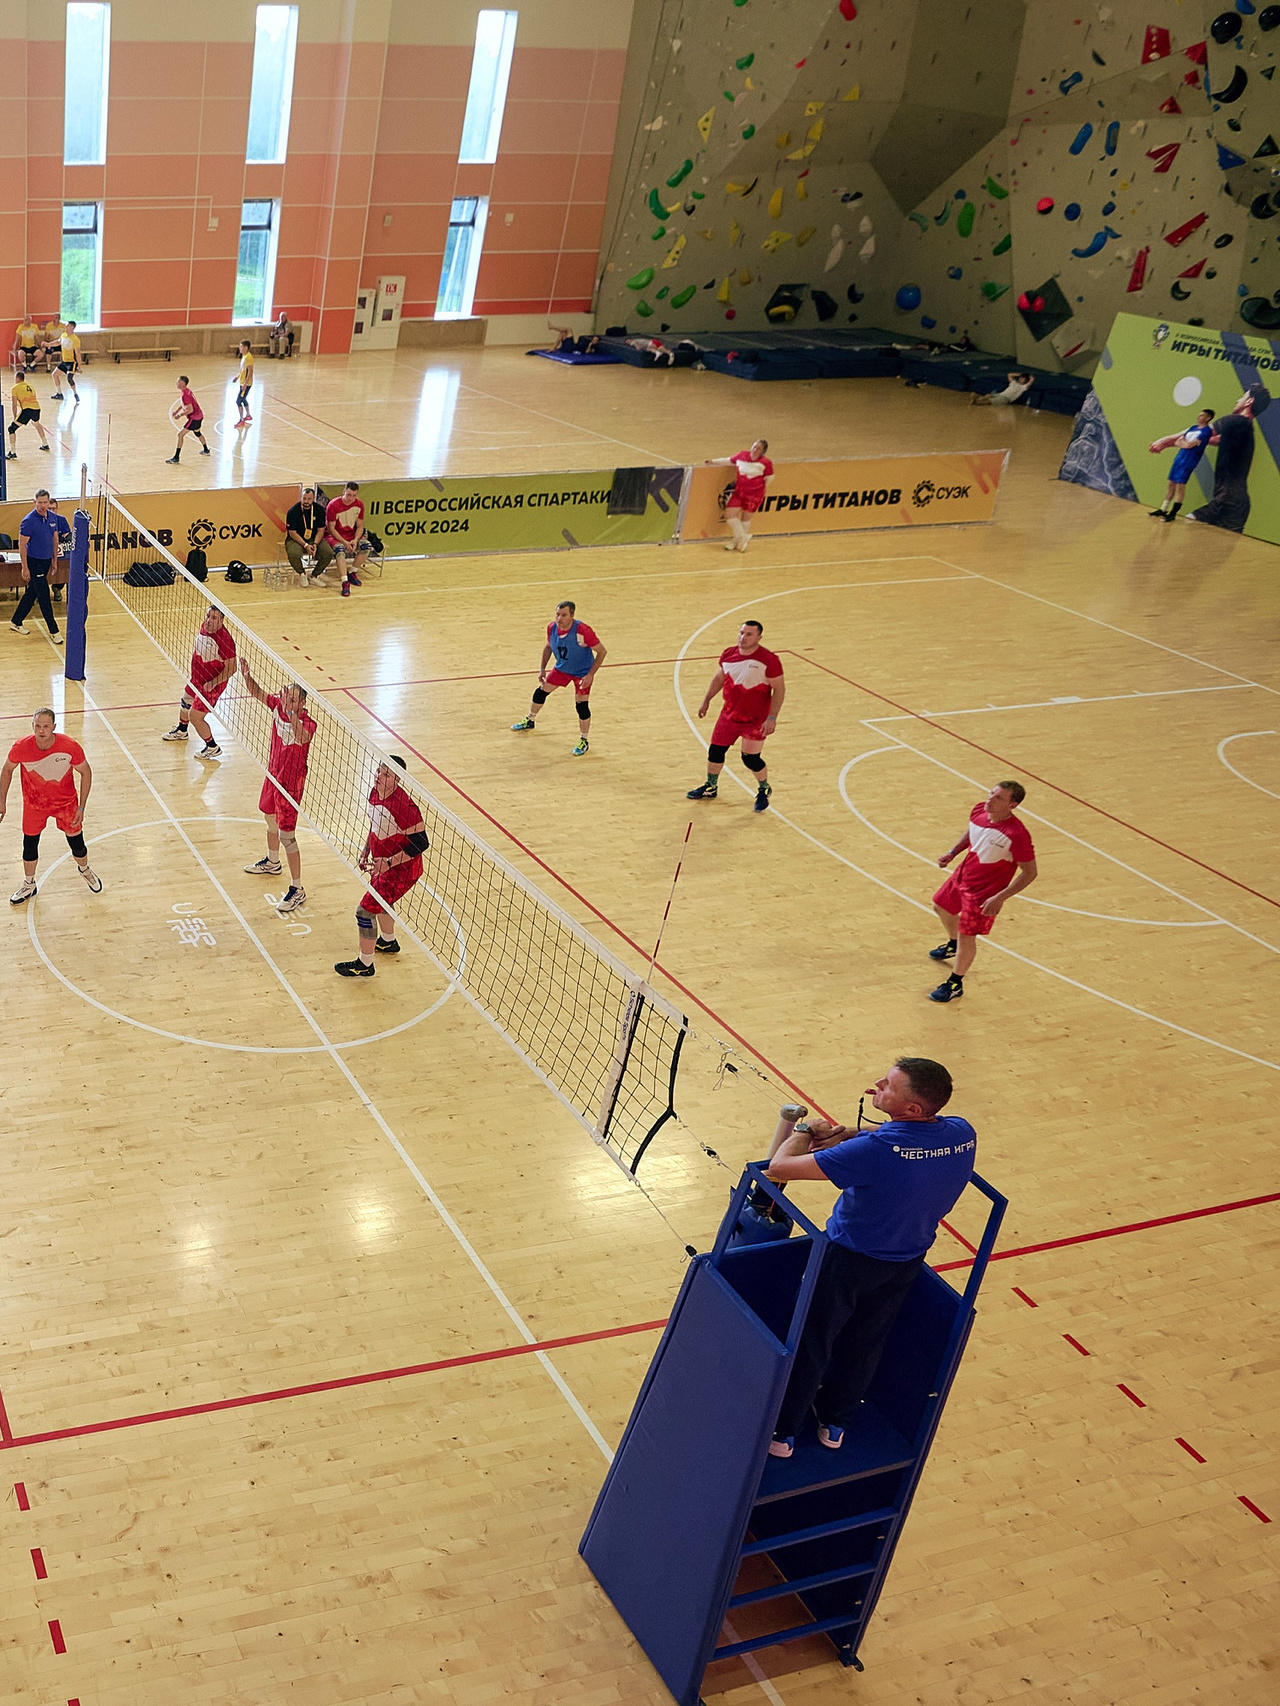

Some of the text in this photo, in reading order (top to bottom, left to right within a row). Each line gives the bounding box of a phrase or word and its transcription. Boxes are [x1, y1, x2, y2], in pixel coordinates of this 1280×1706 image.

[1171, 340, 1211, 357] ИГРЫ
[1213, 348, 1280, 371] ТИТАНОВ
[26, 385, 33, 393] 4
[811, 488, 902, 509] ТИТАНОВ
[936, 485, 971, 500] СУЭК
[383, 494, 524, 515] ВСЕРОССИЙСКАЯ
[527, 489, 612, 509] СПАРТАКИ
[219, 523, 263, 540] СУЭК
[384, 519, 470, 536] СУЭК 2024
[90, 529, 173, 551] ТАНОВ
[900, 1146, 951, 1160] ЧЕСТНАЯ
